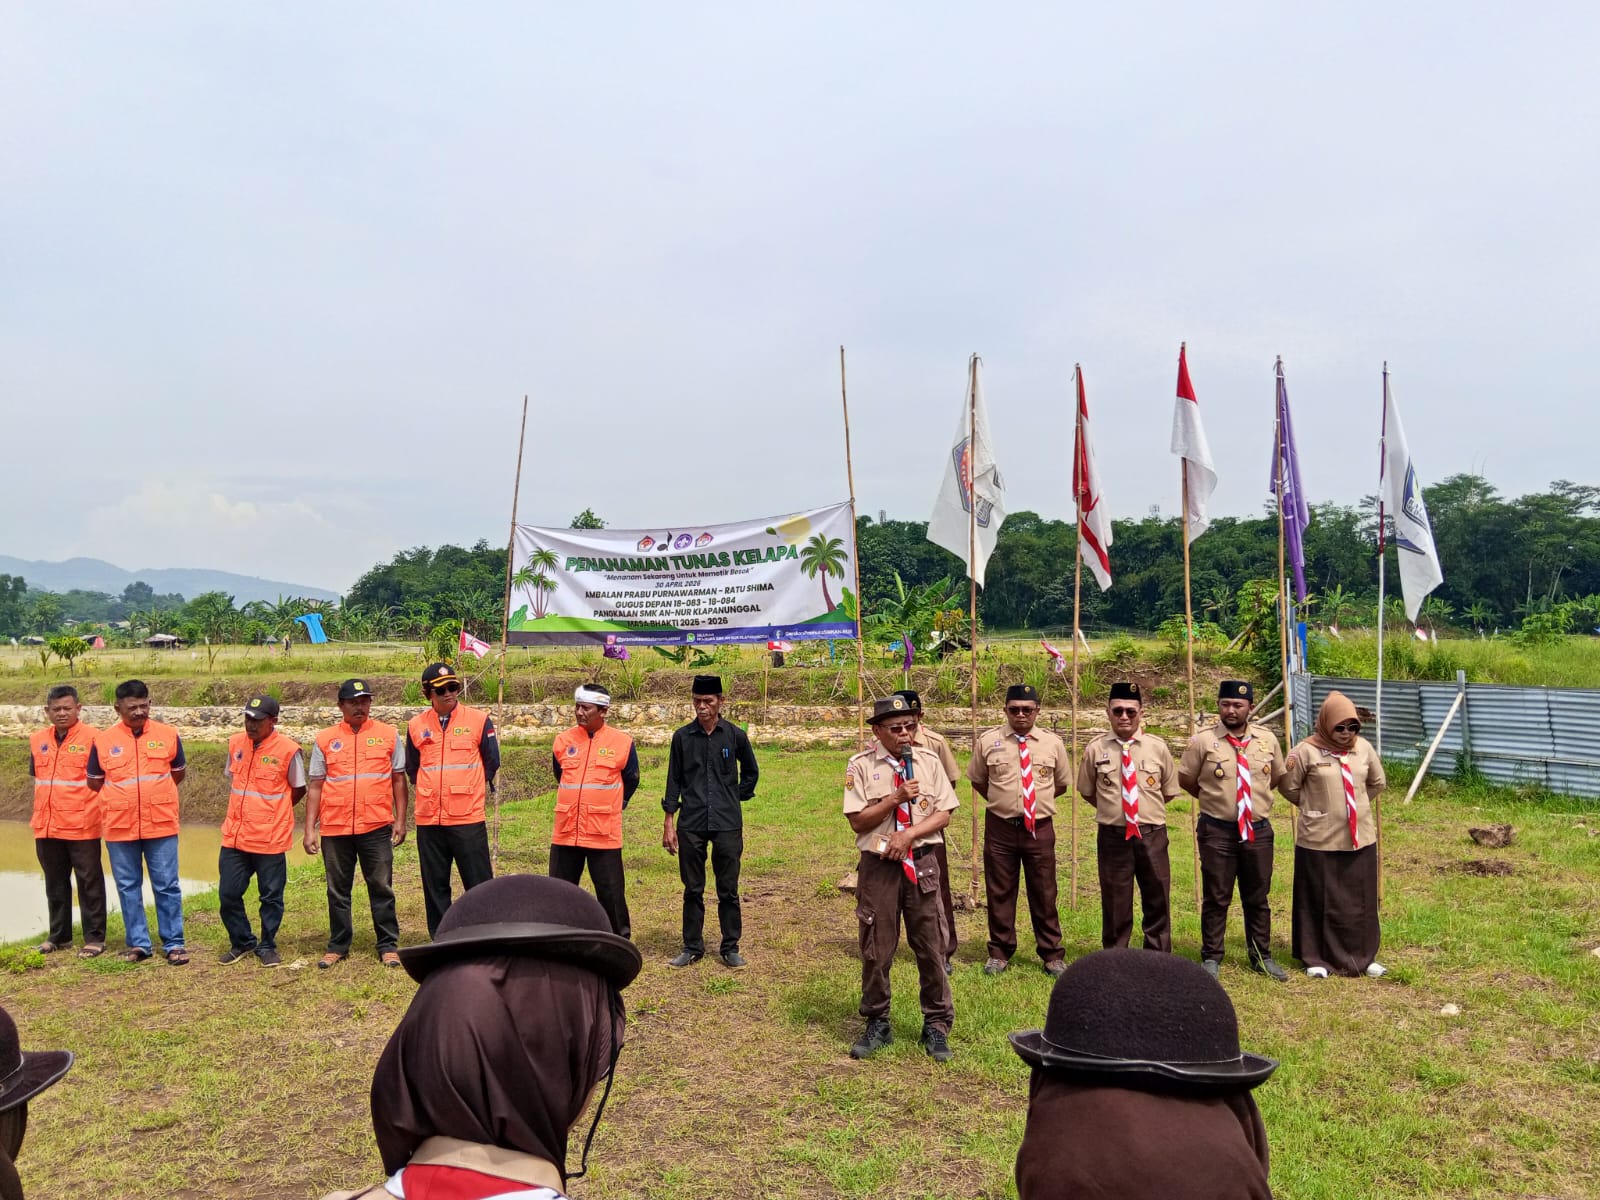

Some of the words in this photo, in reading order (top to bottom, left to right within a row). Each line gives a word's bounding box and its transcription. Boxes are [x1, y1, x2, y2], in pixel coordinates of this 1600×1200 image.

[565, 556, 670, 572] PENANAMAN
[670, 552, 731, 570] TUNAS
[732, 544, 798, 566] KELAPA
[698, 568, 729, 578] Memetik
[652, 588, 717, 598] PURNAWARMAN
[724, 586, 746, 594] RATU
[746, 583, 774, 592] SHIMA
[658, 608, 691, 616] AN-NUR
[693, 604, 761, 615] KLAPANUNGGAL
[708, 617, 728, 625] 2026
